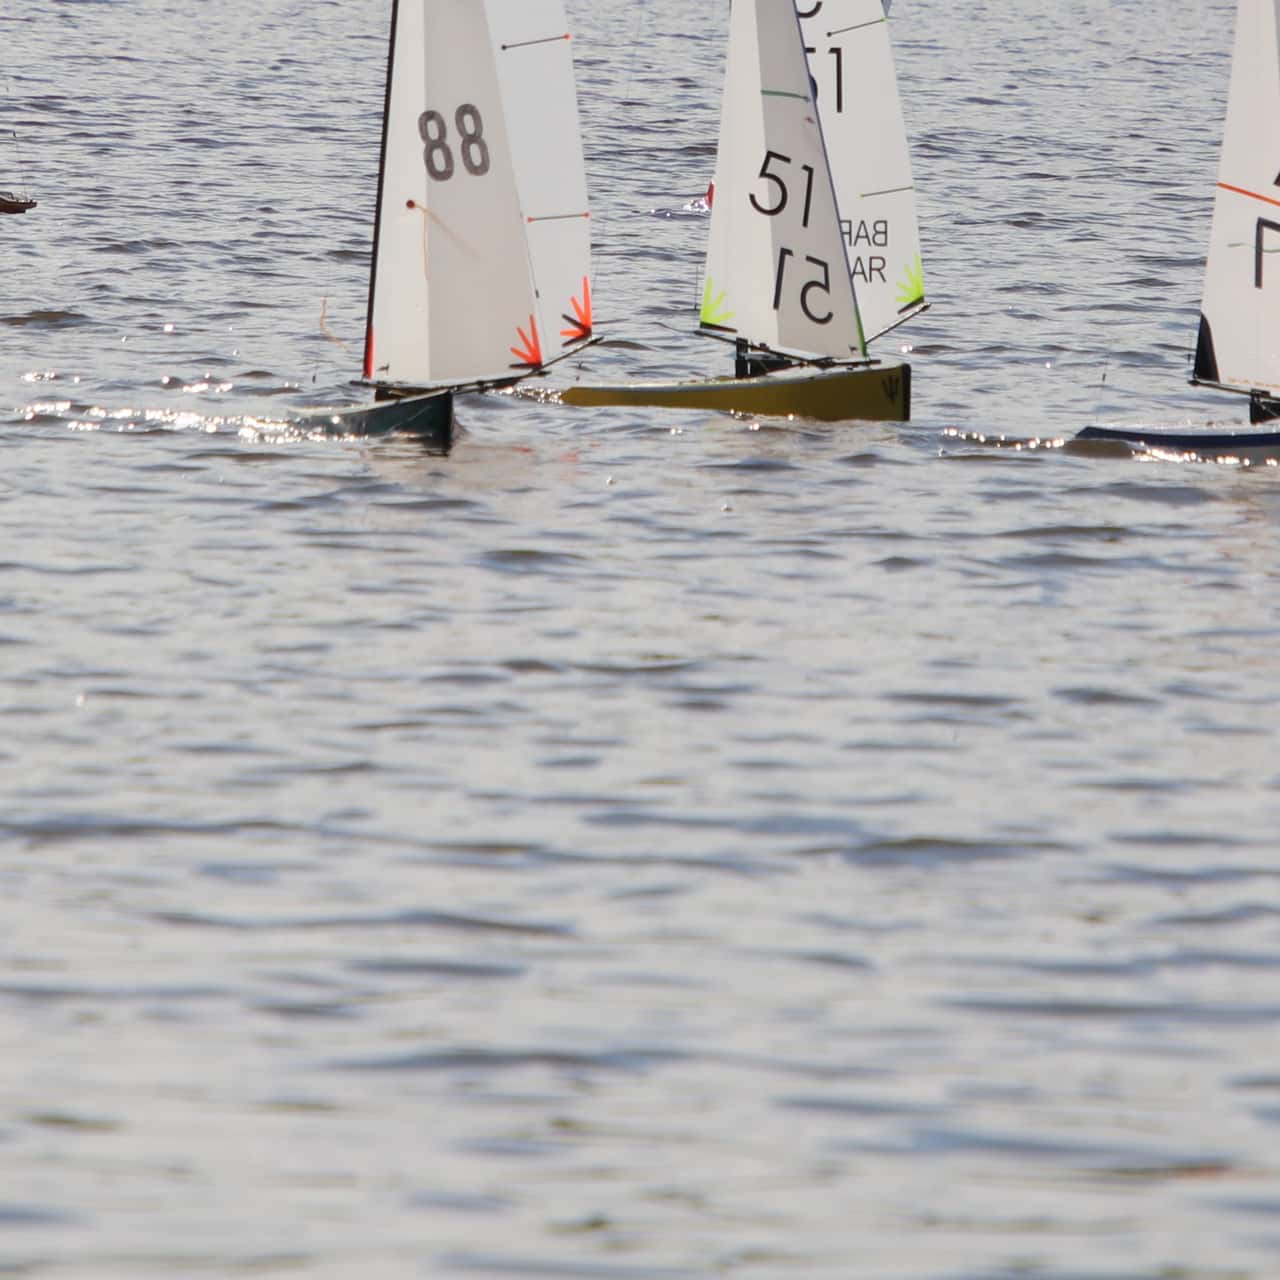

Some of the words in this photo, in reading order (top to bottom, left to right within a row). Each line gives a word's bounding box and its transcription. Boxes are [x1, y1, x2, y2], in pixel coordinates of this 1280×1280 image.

[418, 103, 490, 182] 88
[749, 150, 814, 228] 51
[851, 256, 887, 283] AR
